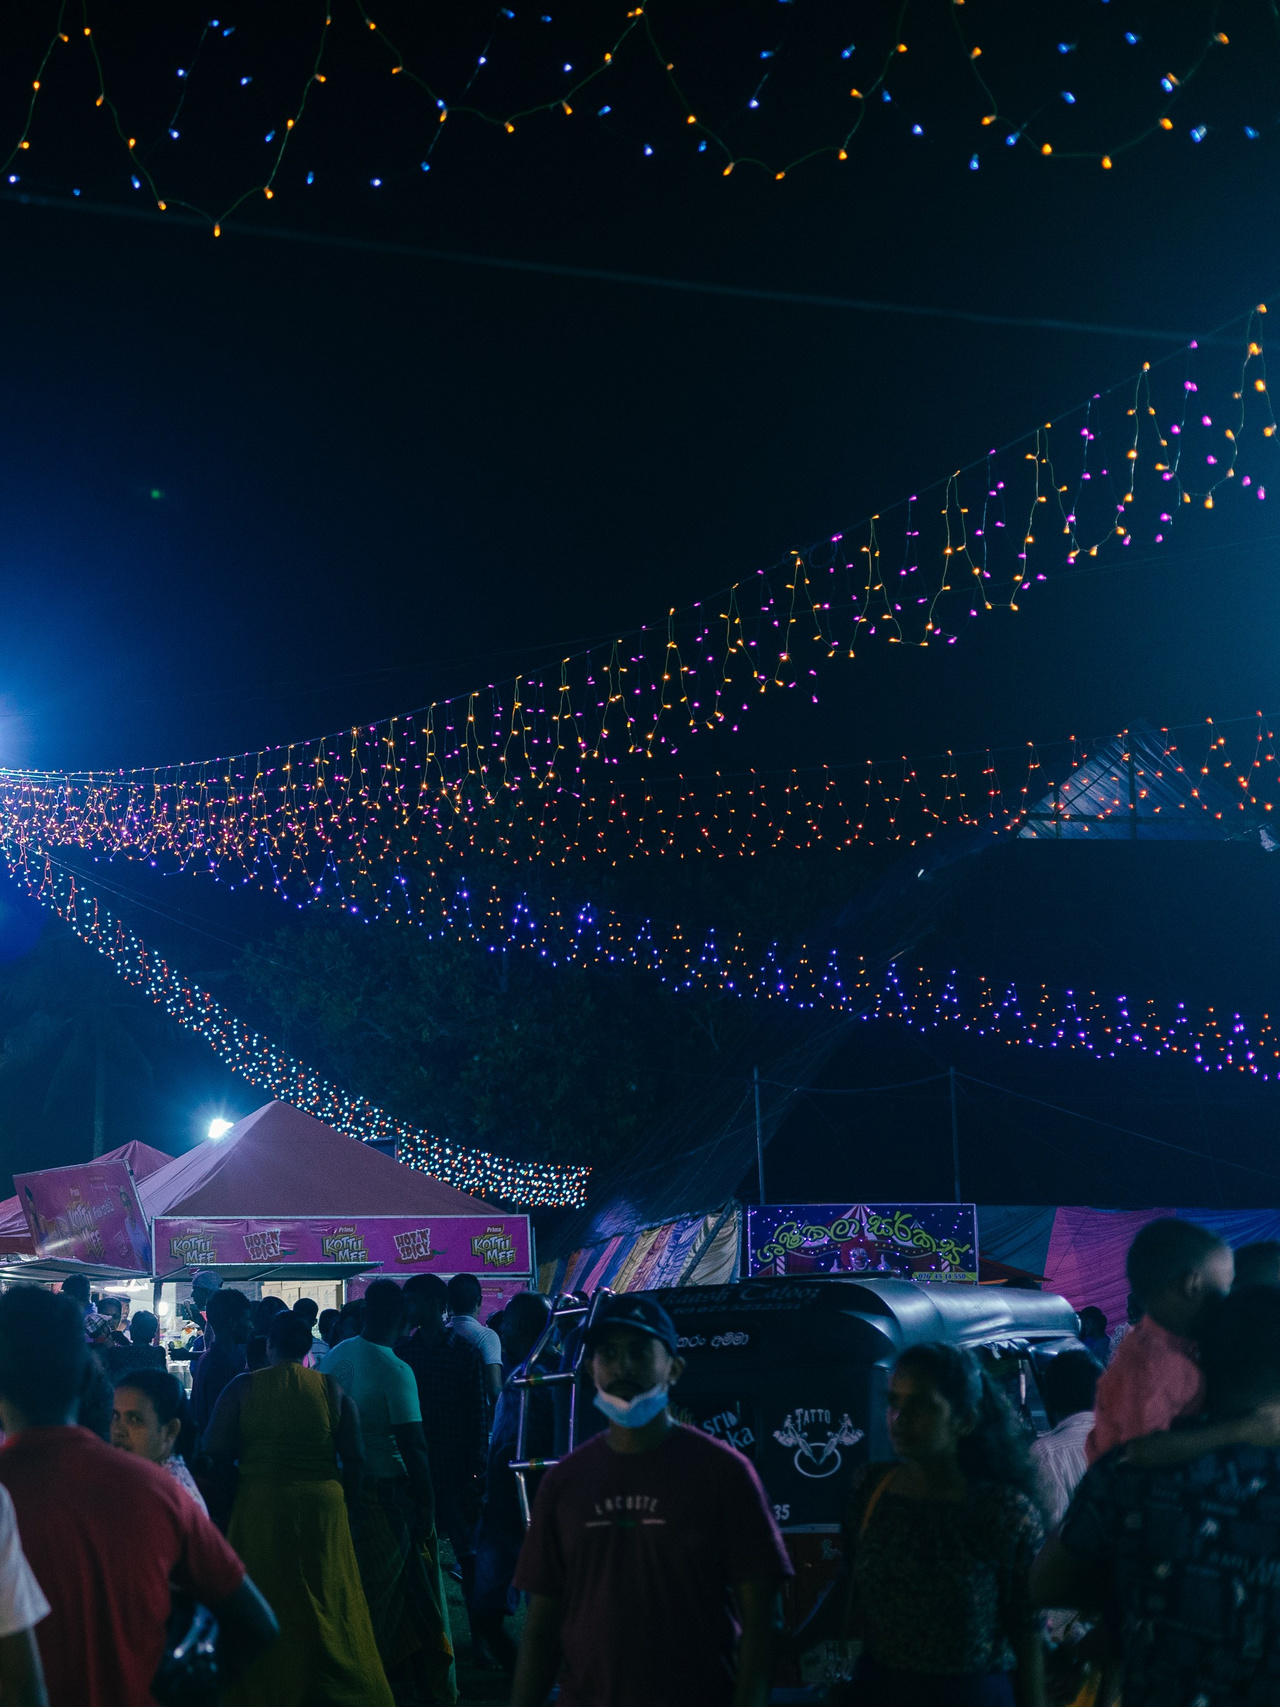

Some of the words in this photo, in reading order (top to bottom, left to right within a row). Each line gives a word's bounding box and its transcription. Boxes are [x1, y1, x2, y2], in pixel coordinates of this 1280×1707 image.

[173, 1237, 210, 1252] KOTTU
[249, 1241, 280, 1260] SPICY
[324, 1236, 363, 1252] KOTTU
[399, 1241, 430, 1260] SPICY
[473, 1236, 510, 1252] KOTTU
[186, 1249, 215, 1263] MEE
[338, 1248, 366, 1262] MEE
[487, 1248, 515, 1261] MEE
[795, 1407, 831, 1431] TATTO
